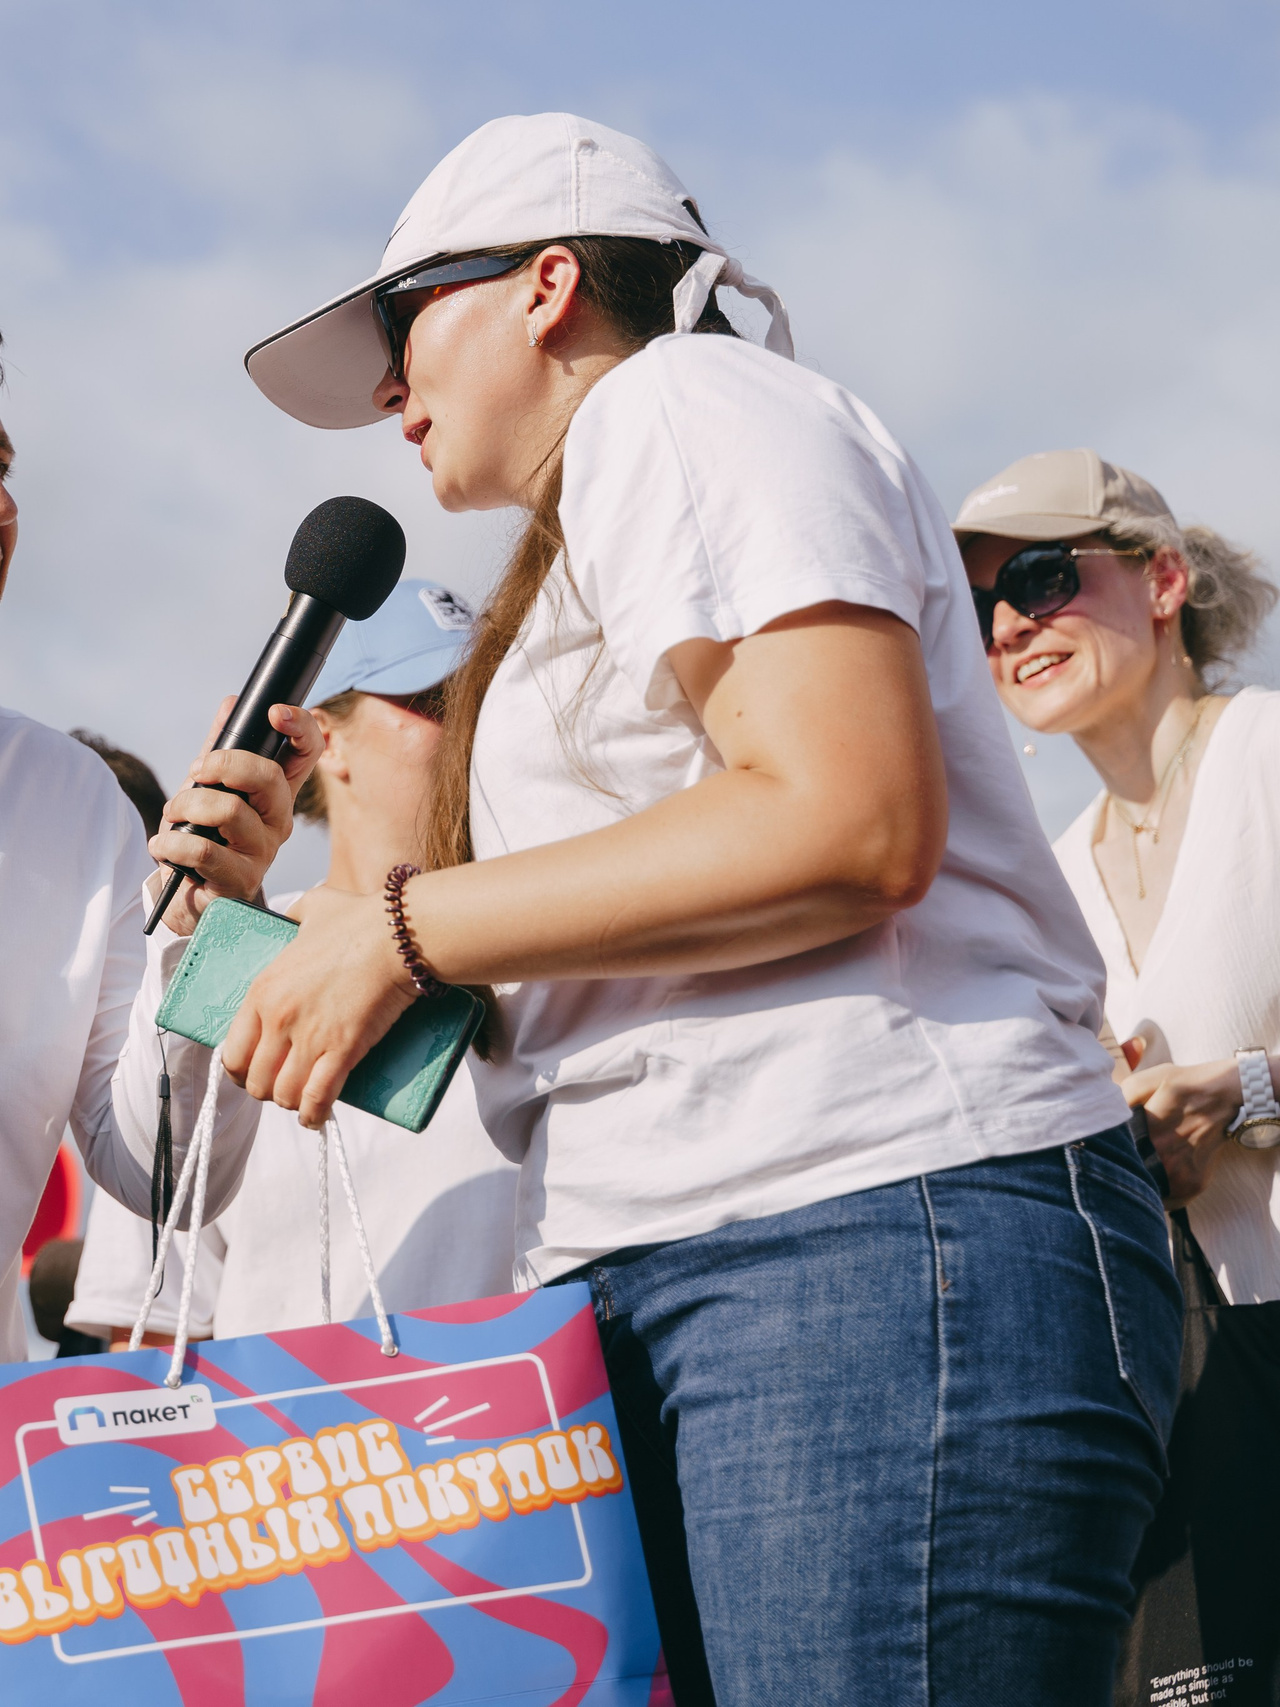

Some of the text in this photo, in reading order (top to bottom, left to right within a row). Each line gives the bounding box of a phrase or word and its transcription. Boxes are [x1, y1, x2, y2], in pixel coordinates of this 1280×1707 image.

[112, 1403, 191, 1426] пакет
[172, 1419, 405, 1524] СЕРВИС
[340, 1424, 617, 1542] ПОКУПОК
[1201, 1658, 1235, 1675] should
[1238, 1657, 1253, 1667] be
[1150, 1673, 1234, 1703] made as simple as
[1191, 1692, 1209, 1705] but
[1210, 1688, 1226, 1700] not
